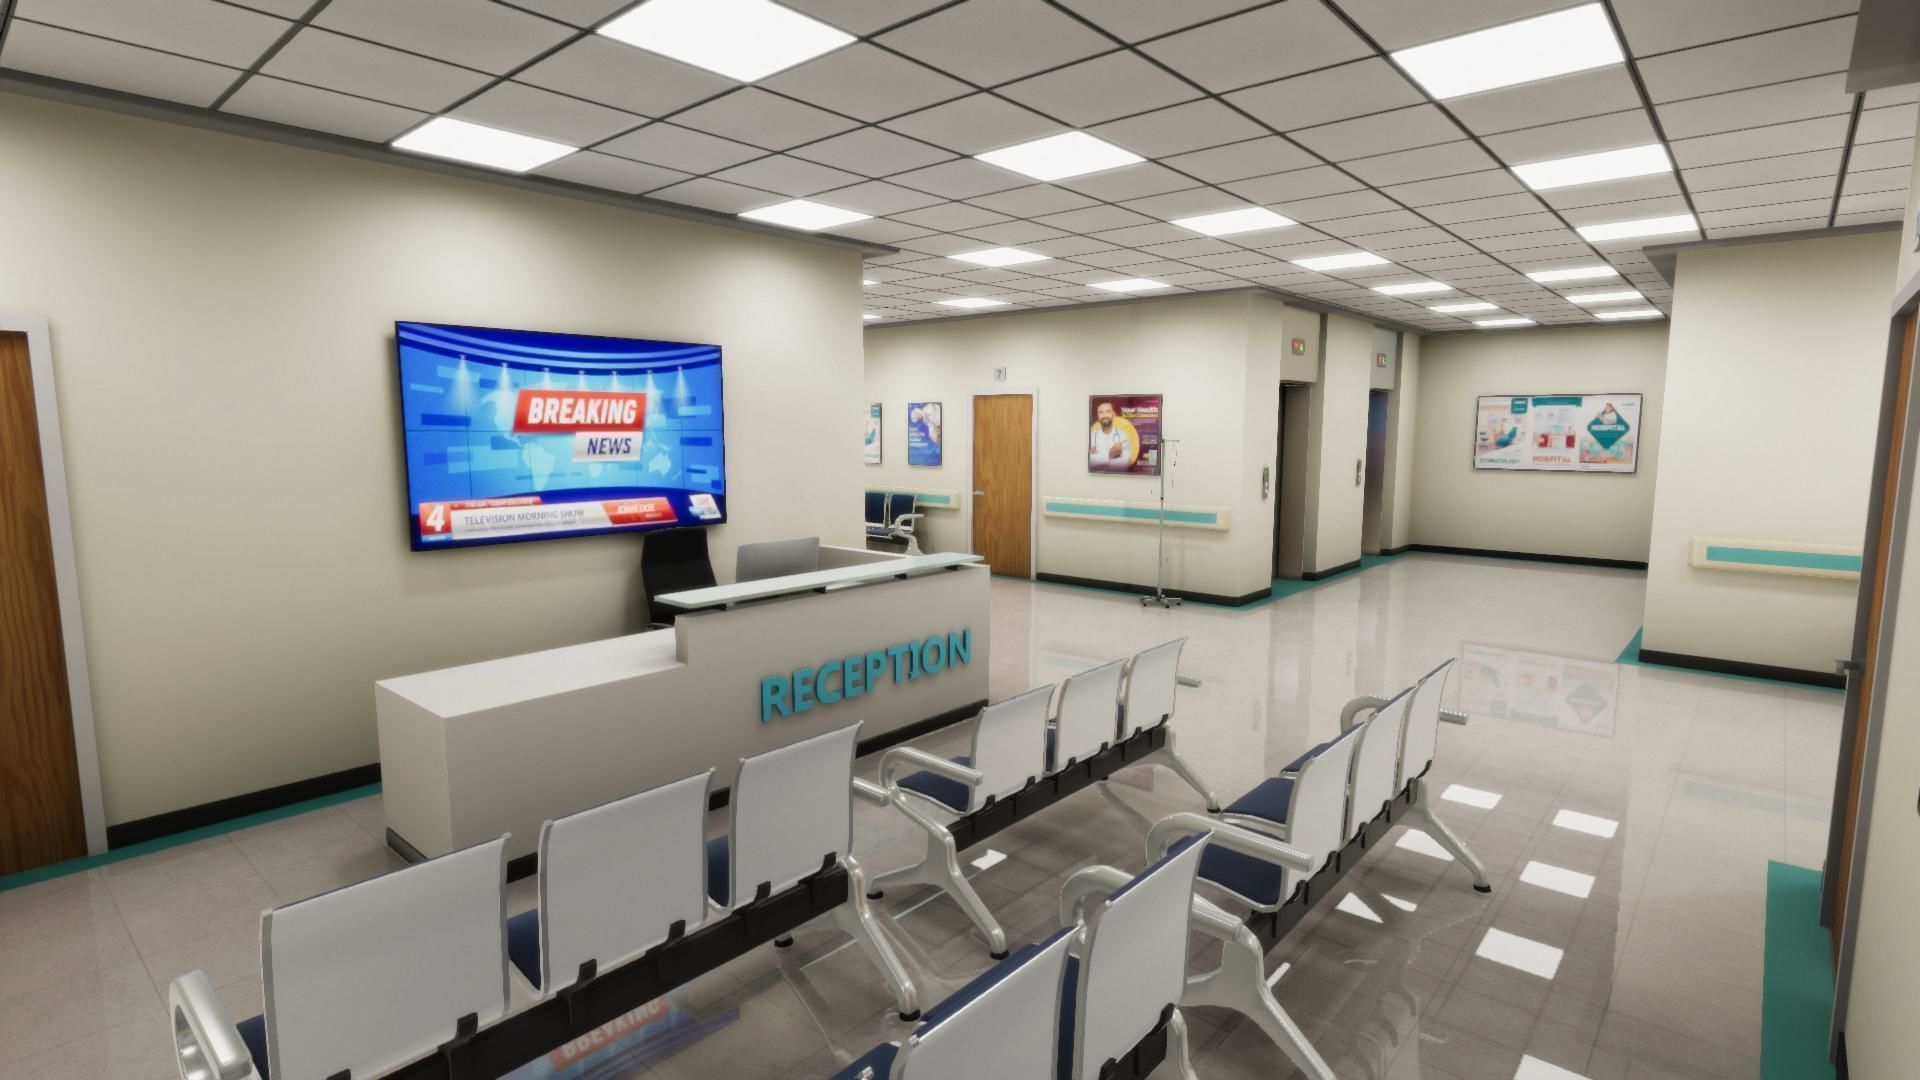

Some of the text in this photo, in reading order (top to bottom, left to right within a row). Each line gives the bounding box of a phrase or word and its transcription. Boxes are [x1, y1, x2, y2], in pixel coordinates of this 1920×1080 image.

[527, 397, 638, 425] BREAKING
[587, 437, 632, 456] NEWS
[426, 504, 446, 533] 4
[464, 512, 516, 526] TELEVISION
[517, 510, 559, 521] MORNING
[760, 627, 972, 722] RECEPTION
